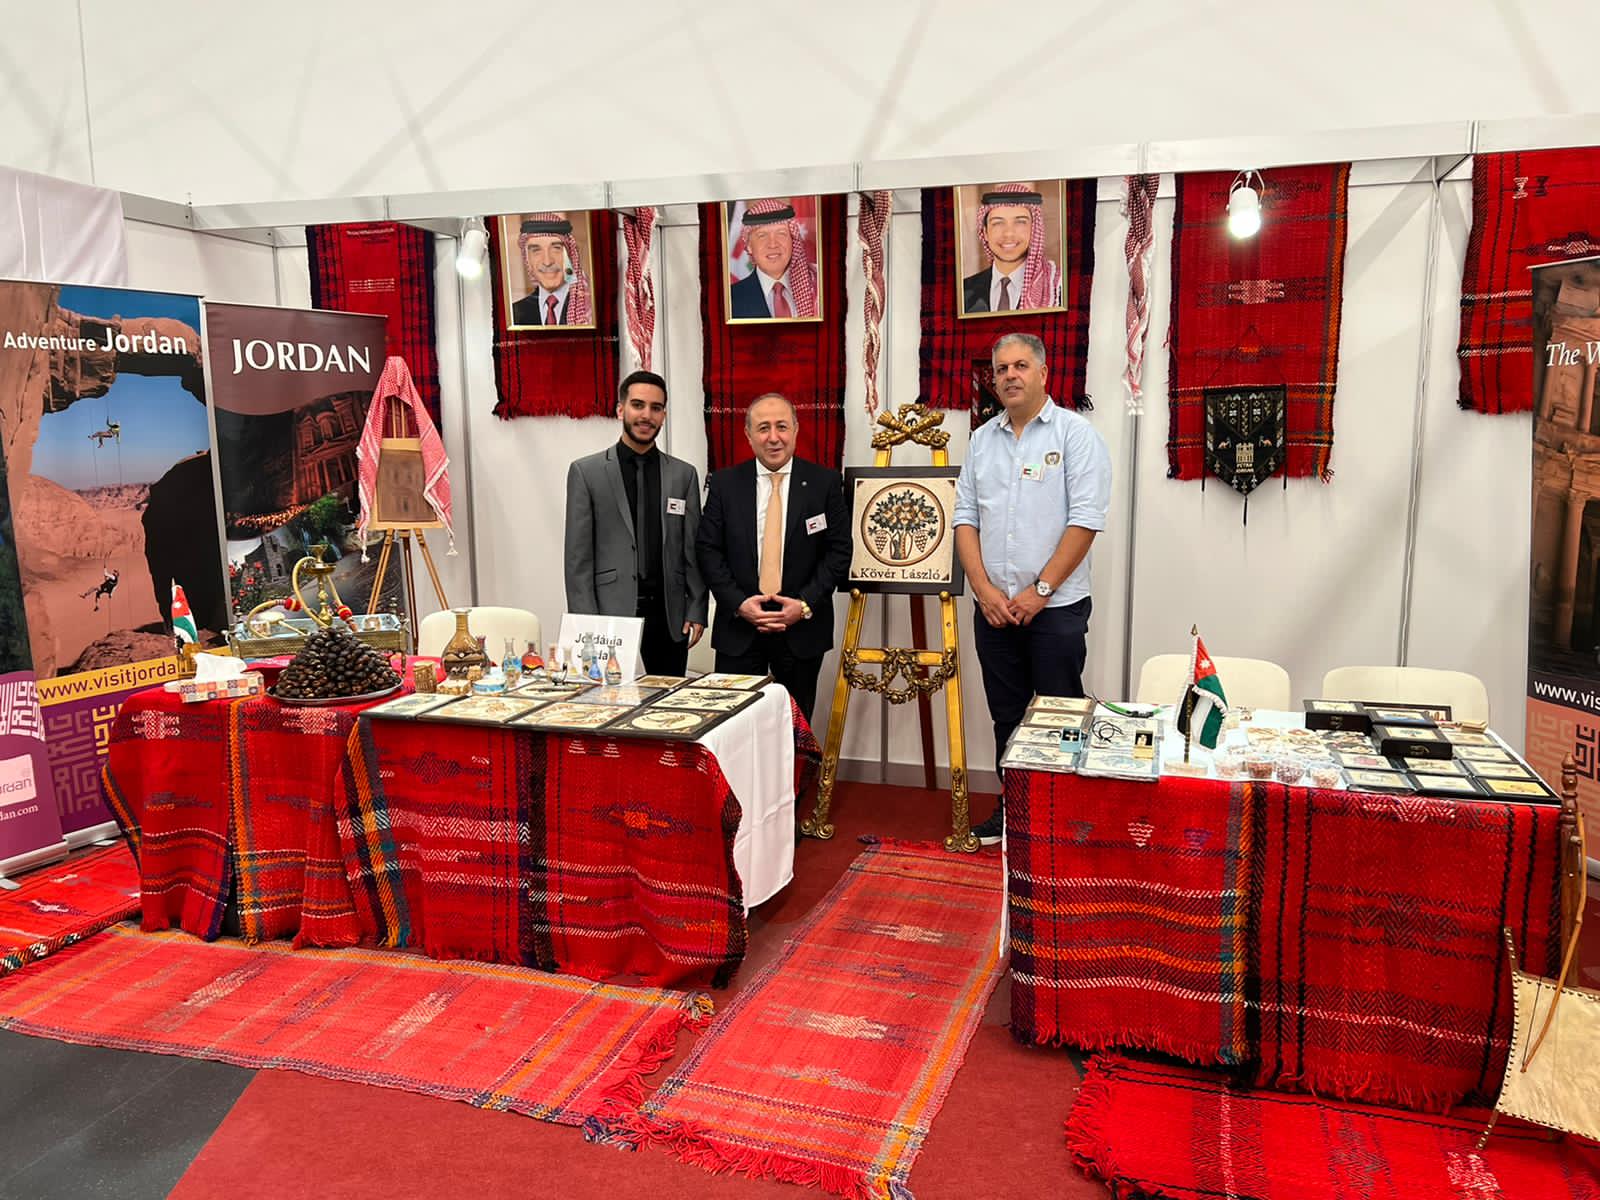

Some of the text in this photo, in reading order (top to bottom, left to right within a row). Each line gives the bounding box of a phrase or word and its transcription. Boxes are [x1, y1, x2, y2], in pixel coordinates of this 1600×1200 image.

[4, 327, 188, 355] Adventure Jordan
[232, 339, 371, 375] JORDAN
[1546, 342, 1581, 367] The
[860, 567, 941, 580] Kövér László
